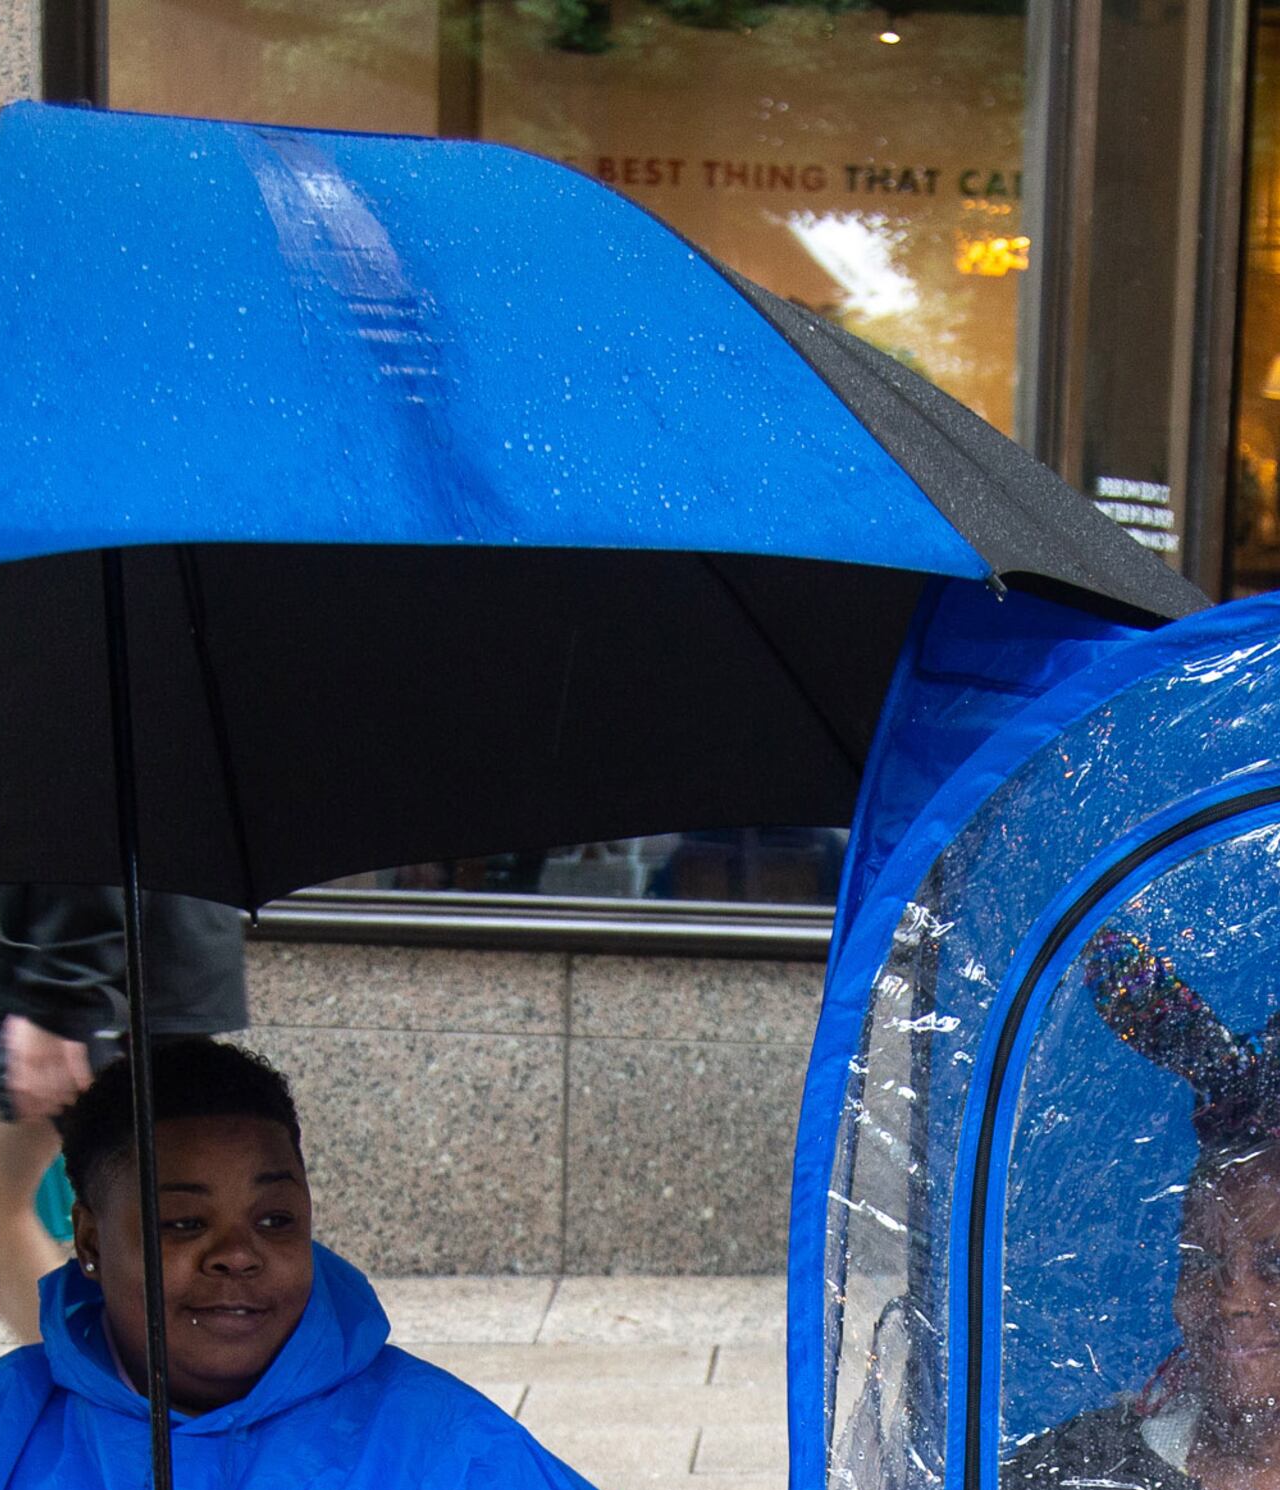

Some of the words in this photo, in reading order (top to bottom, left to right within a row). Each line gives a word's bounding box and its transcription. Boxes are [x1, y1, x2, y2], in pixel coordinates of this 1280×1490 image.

[597, 156, 685, 188] BEST
[703, 160, 827, 194] THING
[845, 164, 940, 198] THAT
